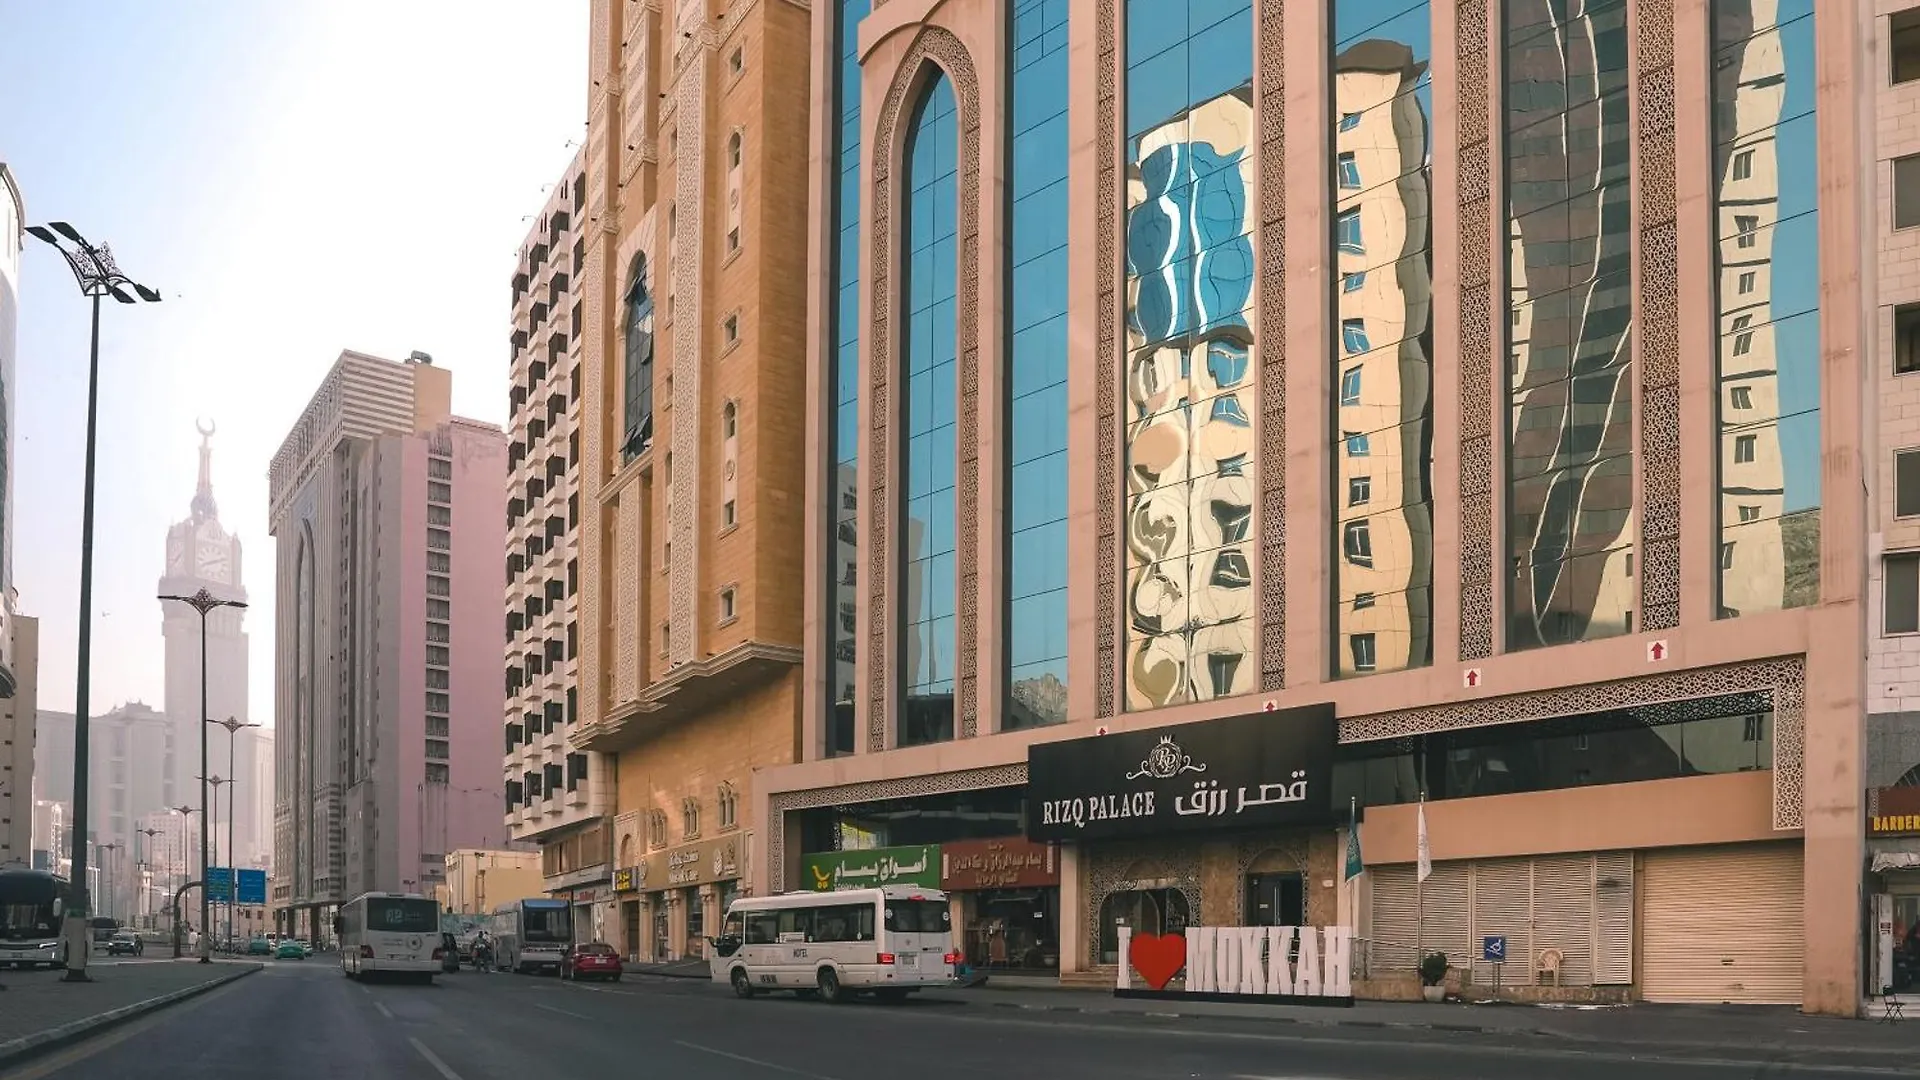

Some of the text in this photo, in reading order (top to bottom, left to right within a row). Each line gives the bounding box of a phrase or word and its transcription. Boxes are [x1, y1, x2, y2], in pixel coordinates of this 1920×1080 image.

[1043, 791, 1155, 828] RIZQ PALACE
[1174, 769, 1308, 816] قصر رزق
[833, 848, 928, 884] أسواق بسام
[1117, 926, 1352, 997] I MOKKAH
